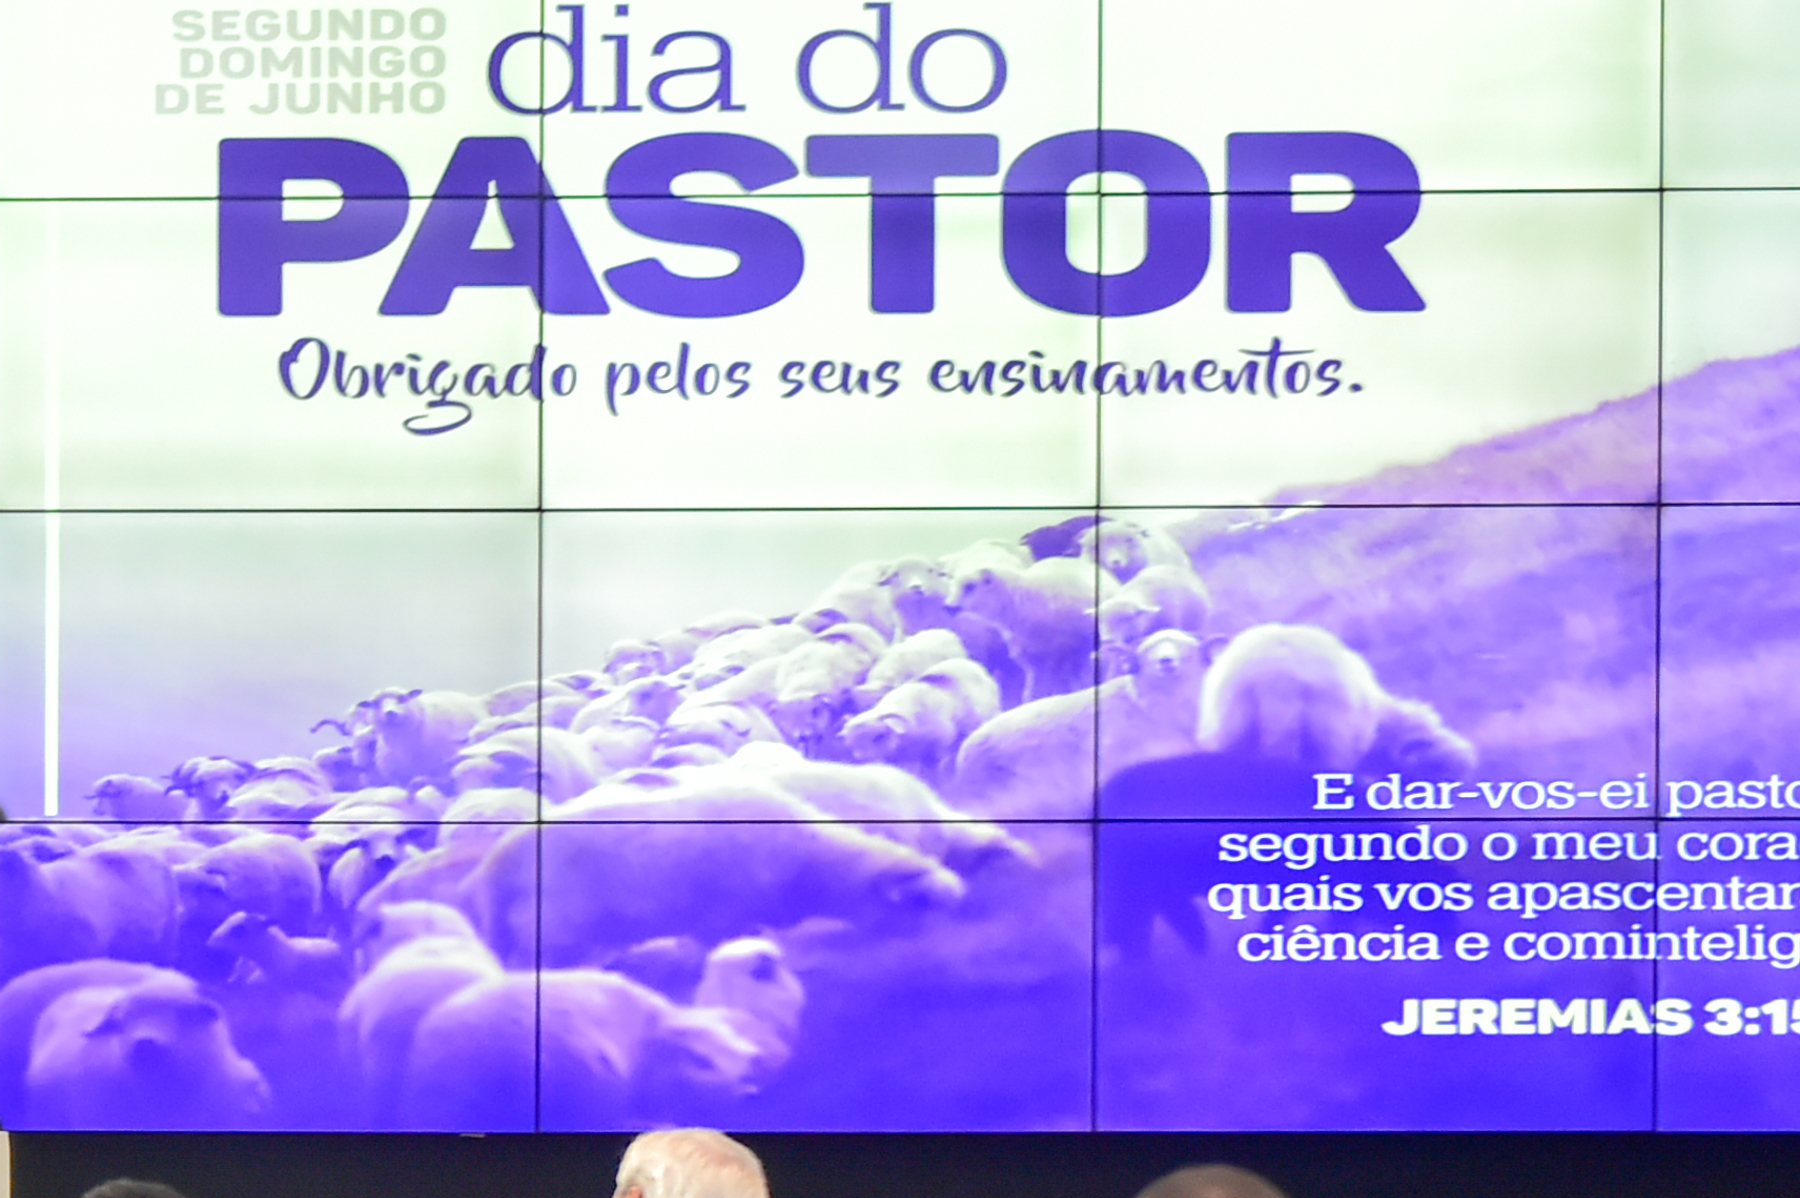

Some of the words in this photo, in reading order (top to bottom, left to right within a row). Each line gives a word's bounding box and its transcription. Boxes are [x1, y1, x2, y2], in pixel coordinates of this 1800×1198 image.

[171, 7, 447, 42] SEGUNDO
[179, 45, 447, 79] DOMINGO
[487, 3, 746, 116] dia
[796, 2, 1008, 114] do
[155, 83, 226, 115] DE
[248, 82, 447, 115] JUNHO
[218, 129, 1427, 319] PASTOR
[279, 337, 578, 435] Obrigado
[605, 342, 753, 416] pelos
[780, 358, 902, 398] seus
[928, 337, 1364, 398] ensinamentos.
[1312, 773, 1354, 810] E
[1366, 771, 1650, 810] dar-vos-ei
[1218, 825, 1468, 870] segundo
[1482, 832, 1518, 861] o
[1532, 832, 1662, 861] meu
[1676, 832, 1800, 861] cora
[1207, 875, 1364, 920] quais
[1373, 882, 1474, 911] vos
[1487, 876, 1800, 919] apascentar
[1237, 924, 1443, 962] ciência
[1455, 932, 1490, 961] e
[1503, 923, 1800, 970] comintelig
[1381, 998, 1693, 1036] JEREMIAS
[1703, 998, 1800, 1036] 3:1
